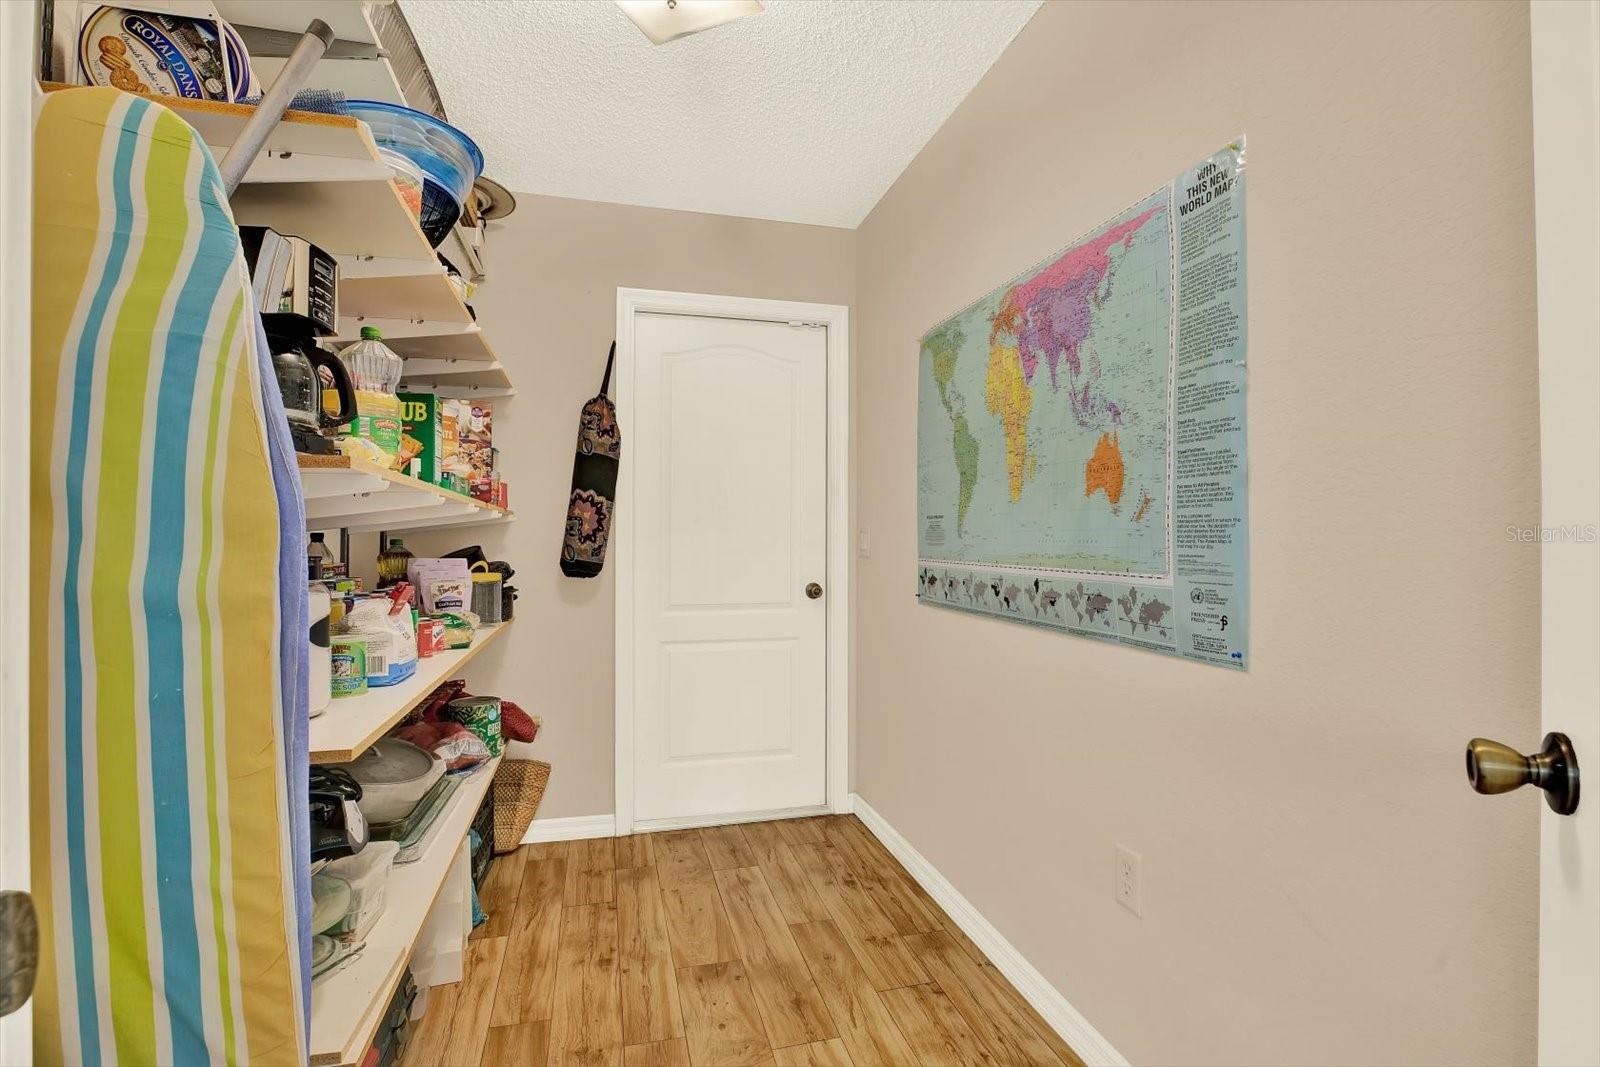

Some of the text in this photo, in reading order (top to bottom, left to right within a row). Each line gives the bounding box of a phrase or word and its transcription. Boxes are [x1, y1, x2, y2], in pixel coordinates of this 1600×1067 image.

[132, 21, 198, 98] ROYAL DANS
[1186, 168, 1230, 199] THIS NEW
[1197, 164, 1216, 181] WHY
[1180, 192, 1212, 216] WORLD
[400, 402, 428, 422] UB
